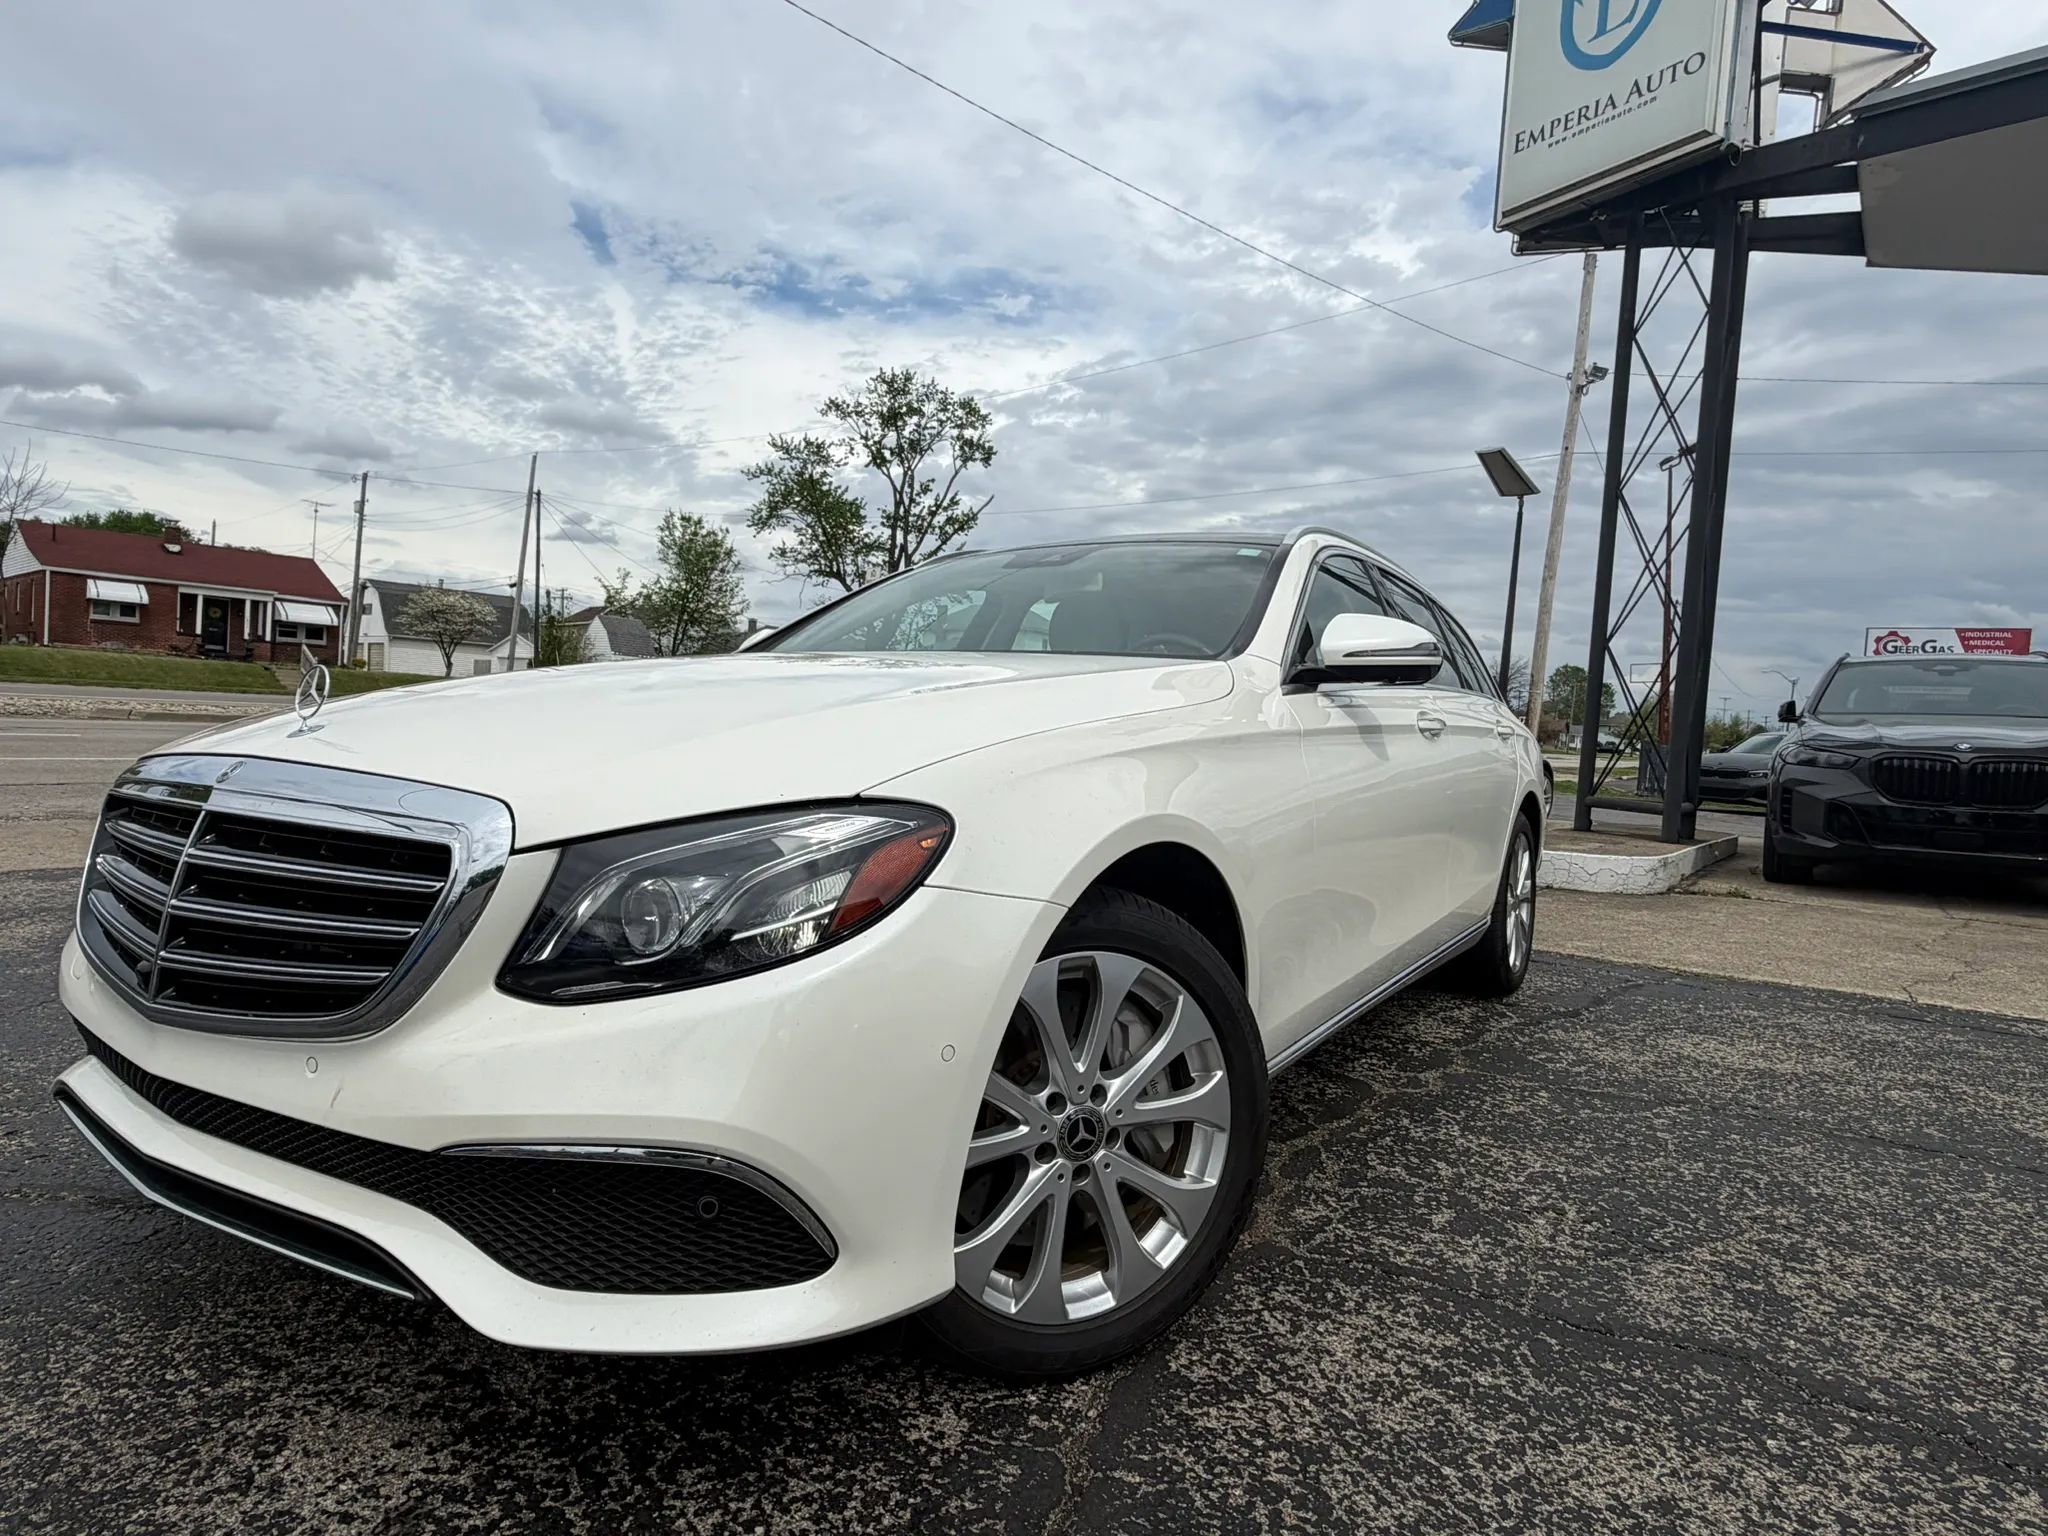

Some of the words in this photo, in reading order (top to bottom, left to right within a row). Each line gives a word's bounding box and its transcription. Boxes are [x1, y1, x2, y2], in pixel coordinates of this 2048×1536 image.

[1513, 93, 1618, 154] EMPERIA
[1623, 52, 1706, 104] AUTO
[1547, 95, 1658, 149] www.emperiaauto.com
